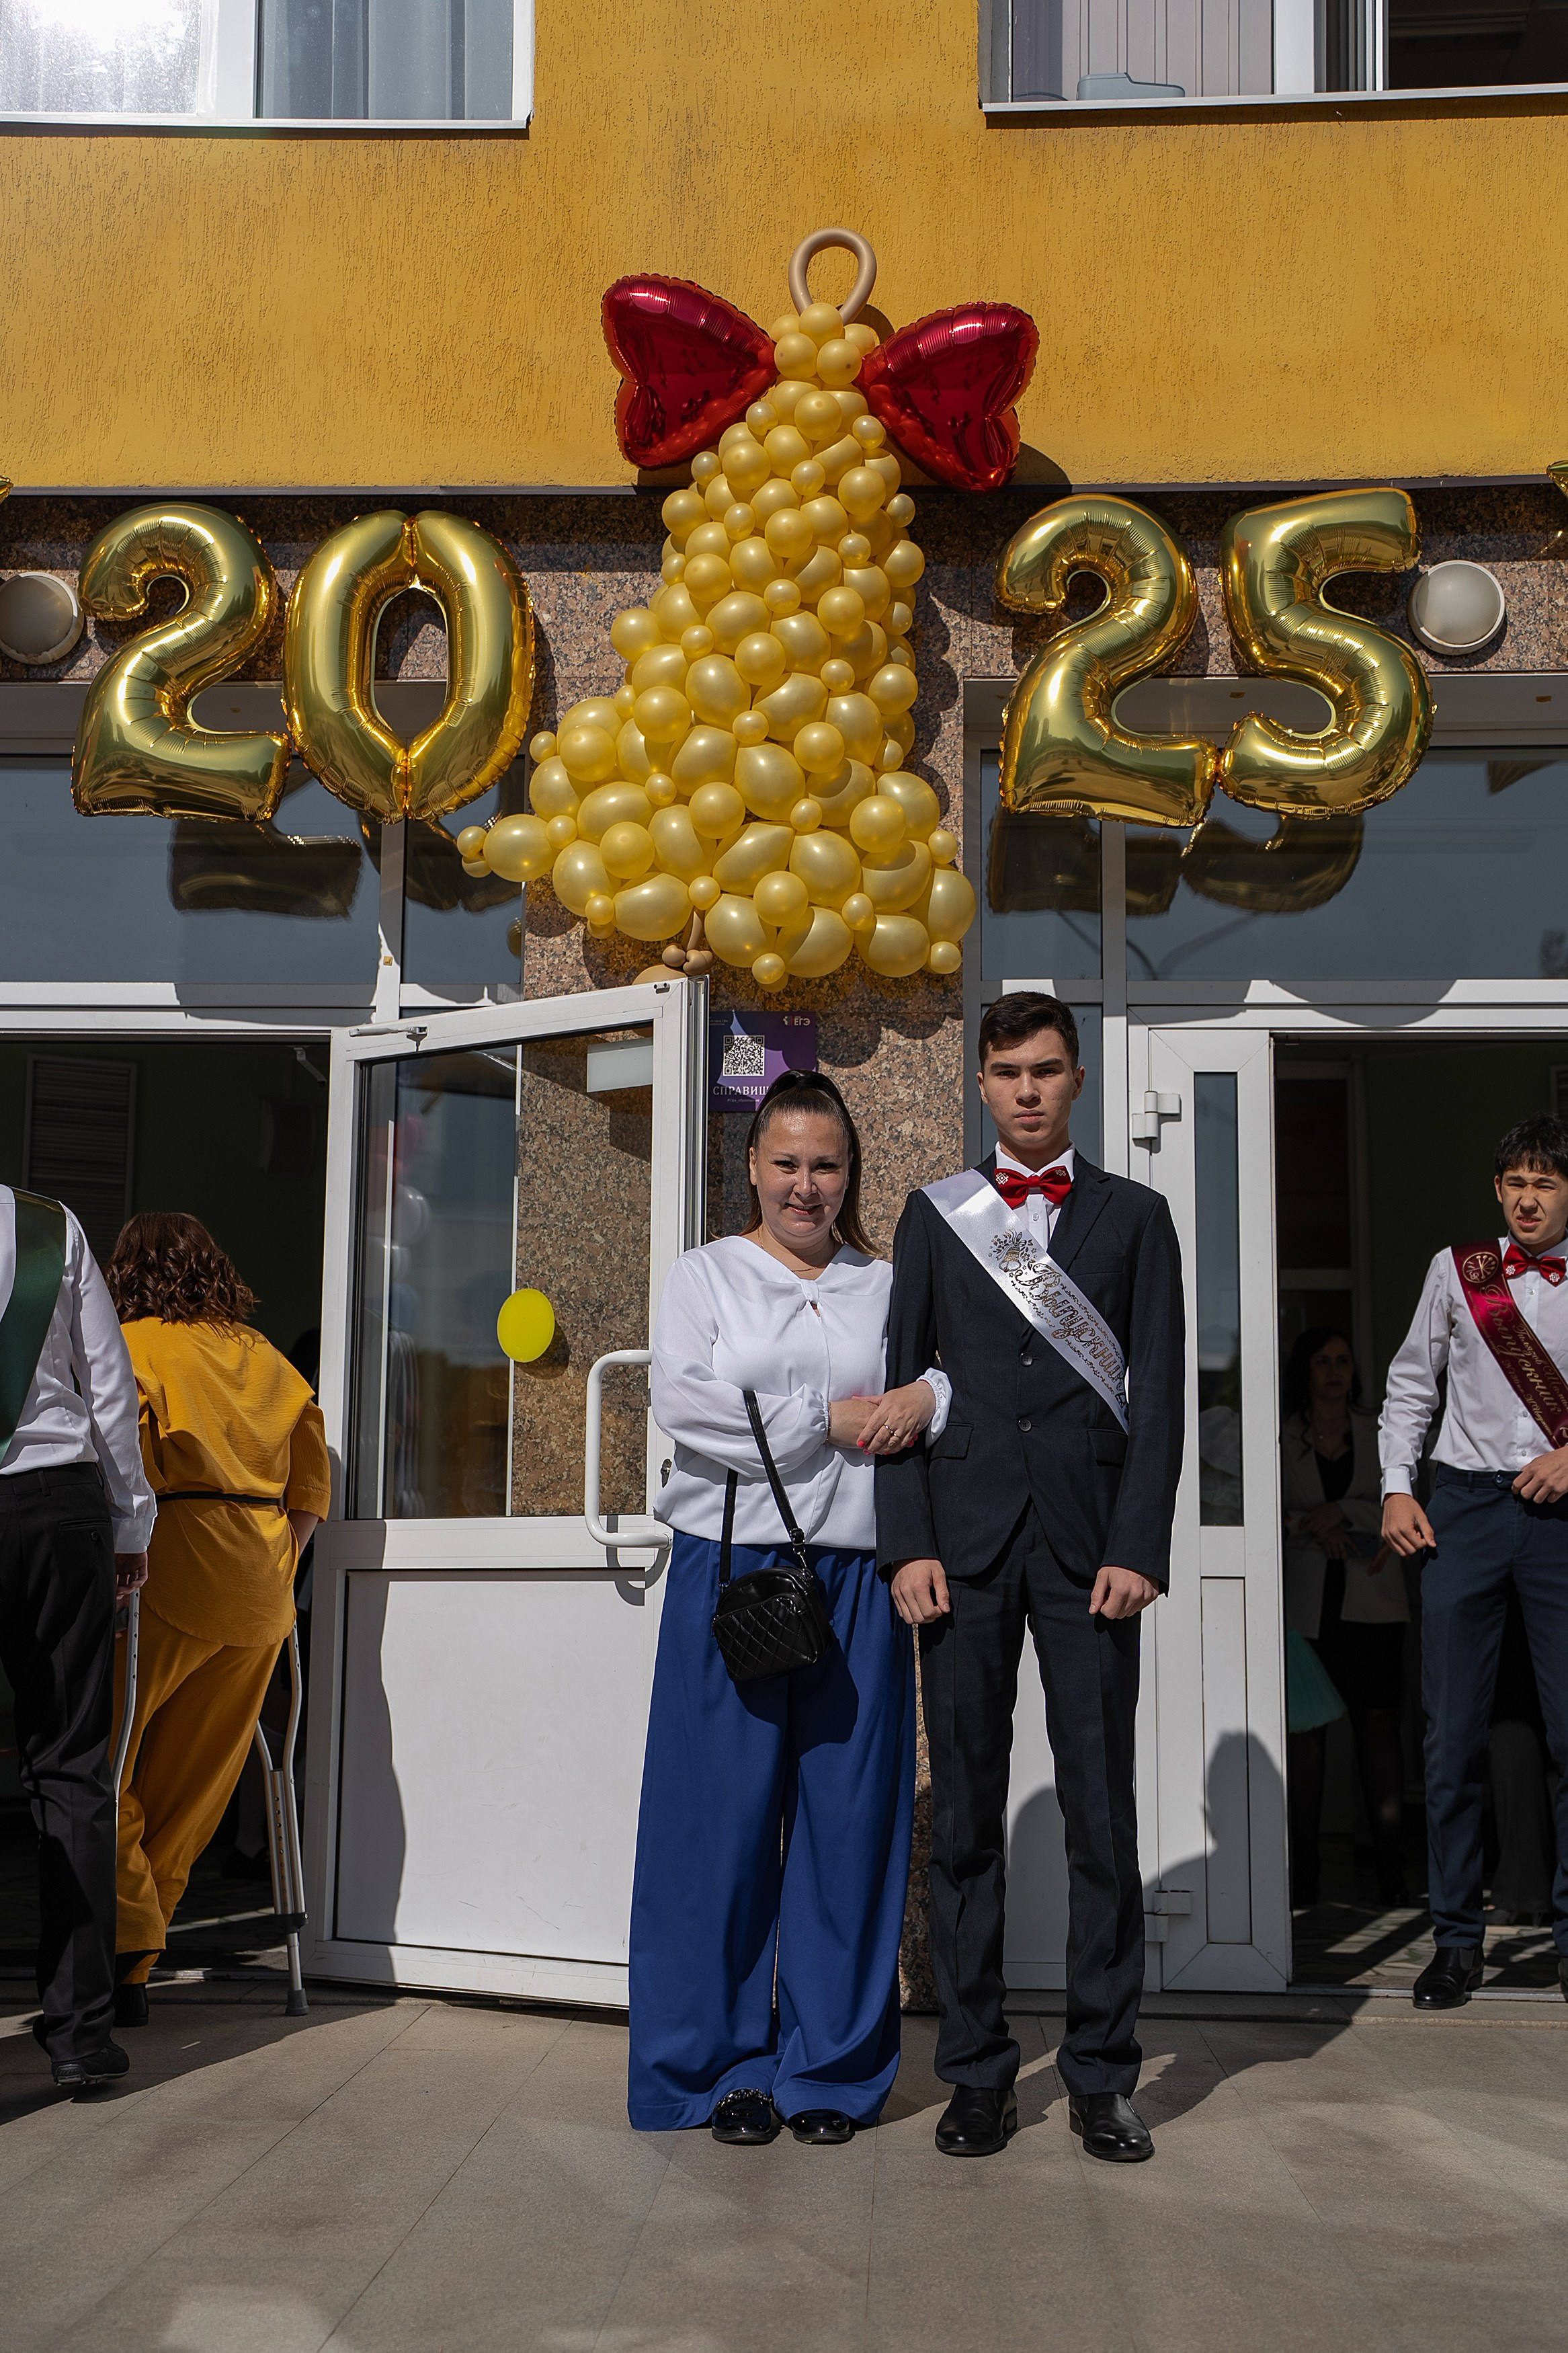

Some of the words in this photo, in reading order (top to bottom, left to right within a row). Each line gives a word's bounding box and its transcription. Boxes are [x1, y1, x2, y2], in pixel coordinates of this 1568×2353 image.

[794, 1017, 811, 1026] ЕГЭ
[1014, 1263, 1124, 1391] Выпускник
[1479, 1285, 1561, 1414] Выпускник
